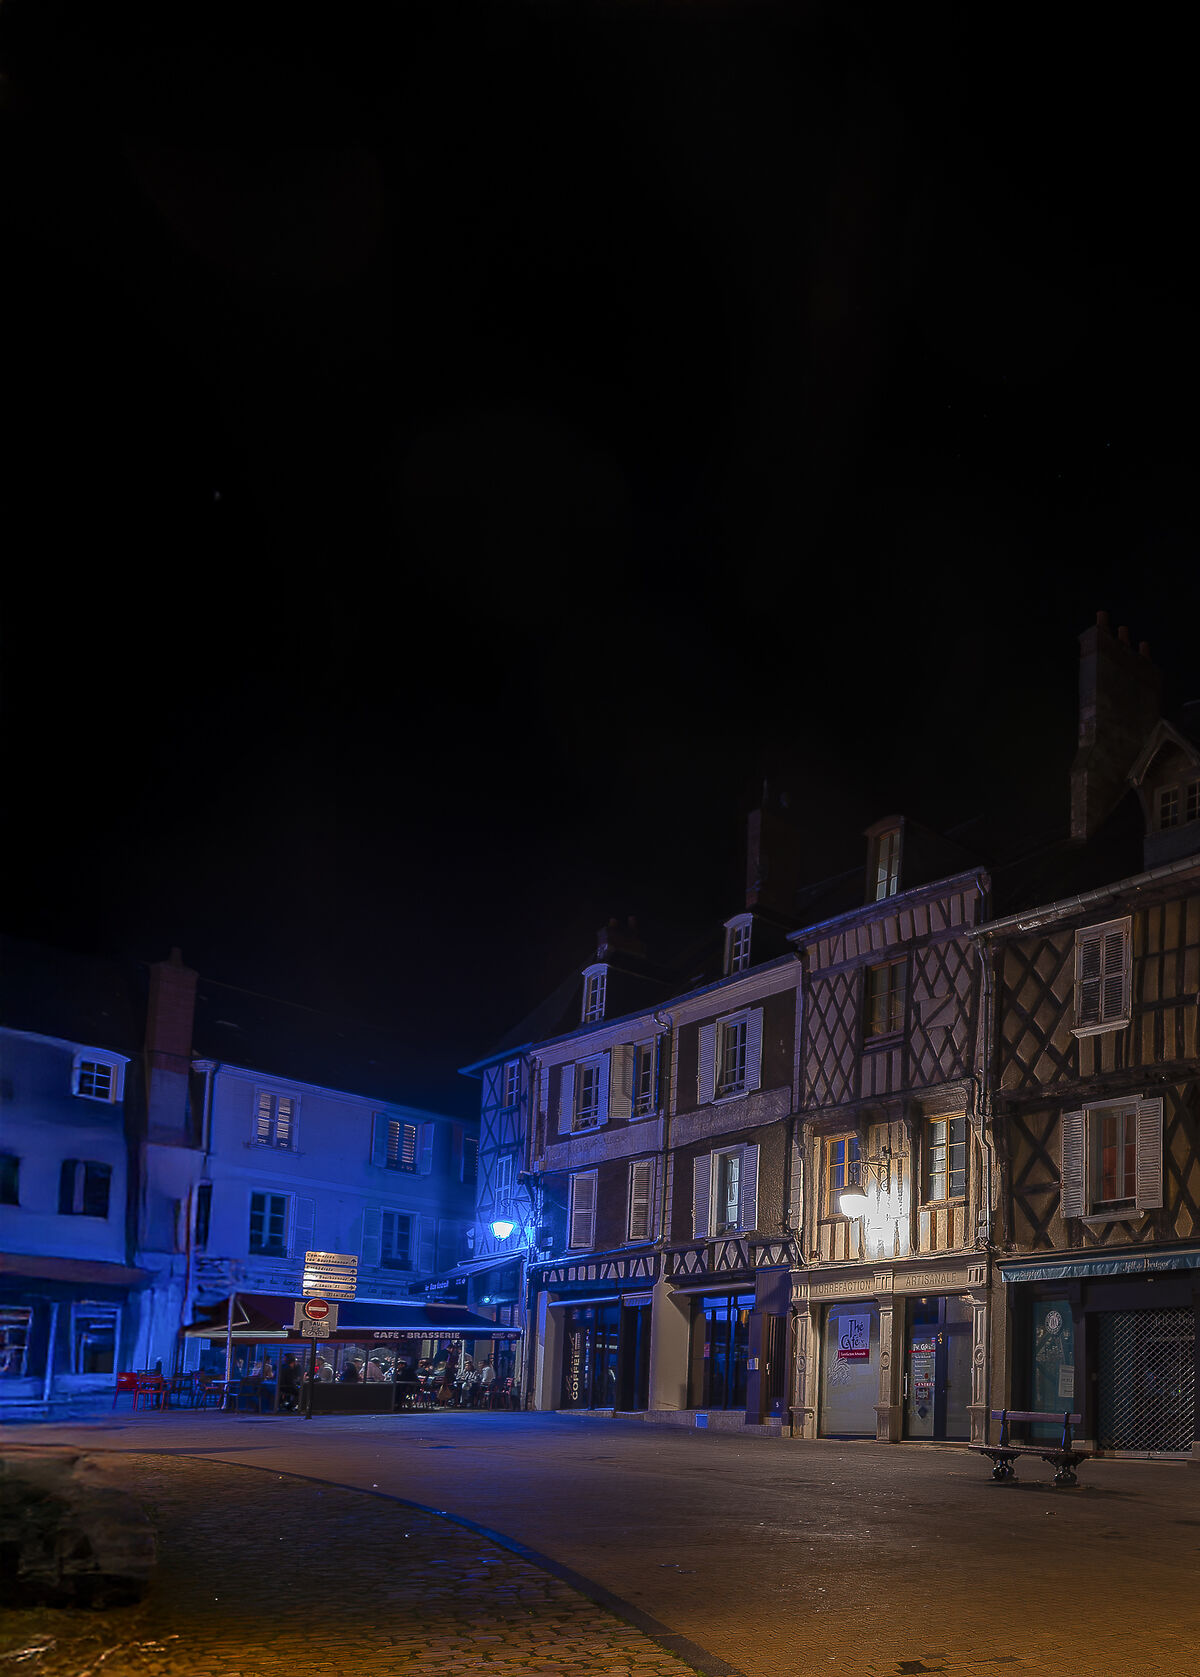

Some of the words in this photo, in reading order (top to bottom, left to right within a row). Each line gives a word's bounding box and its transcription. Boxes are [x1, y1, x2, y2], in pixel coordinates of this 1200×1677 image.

[905, 1272, 957, 1287] ARTISANALE
[373, 1330, 400, 1339] CAFÉ
[407, 1331, 461, 1339] BRASSERIE
